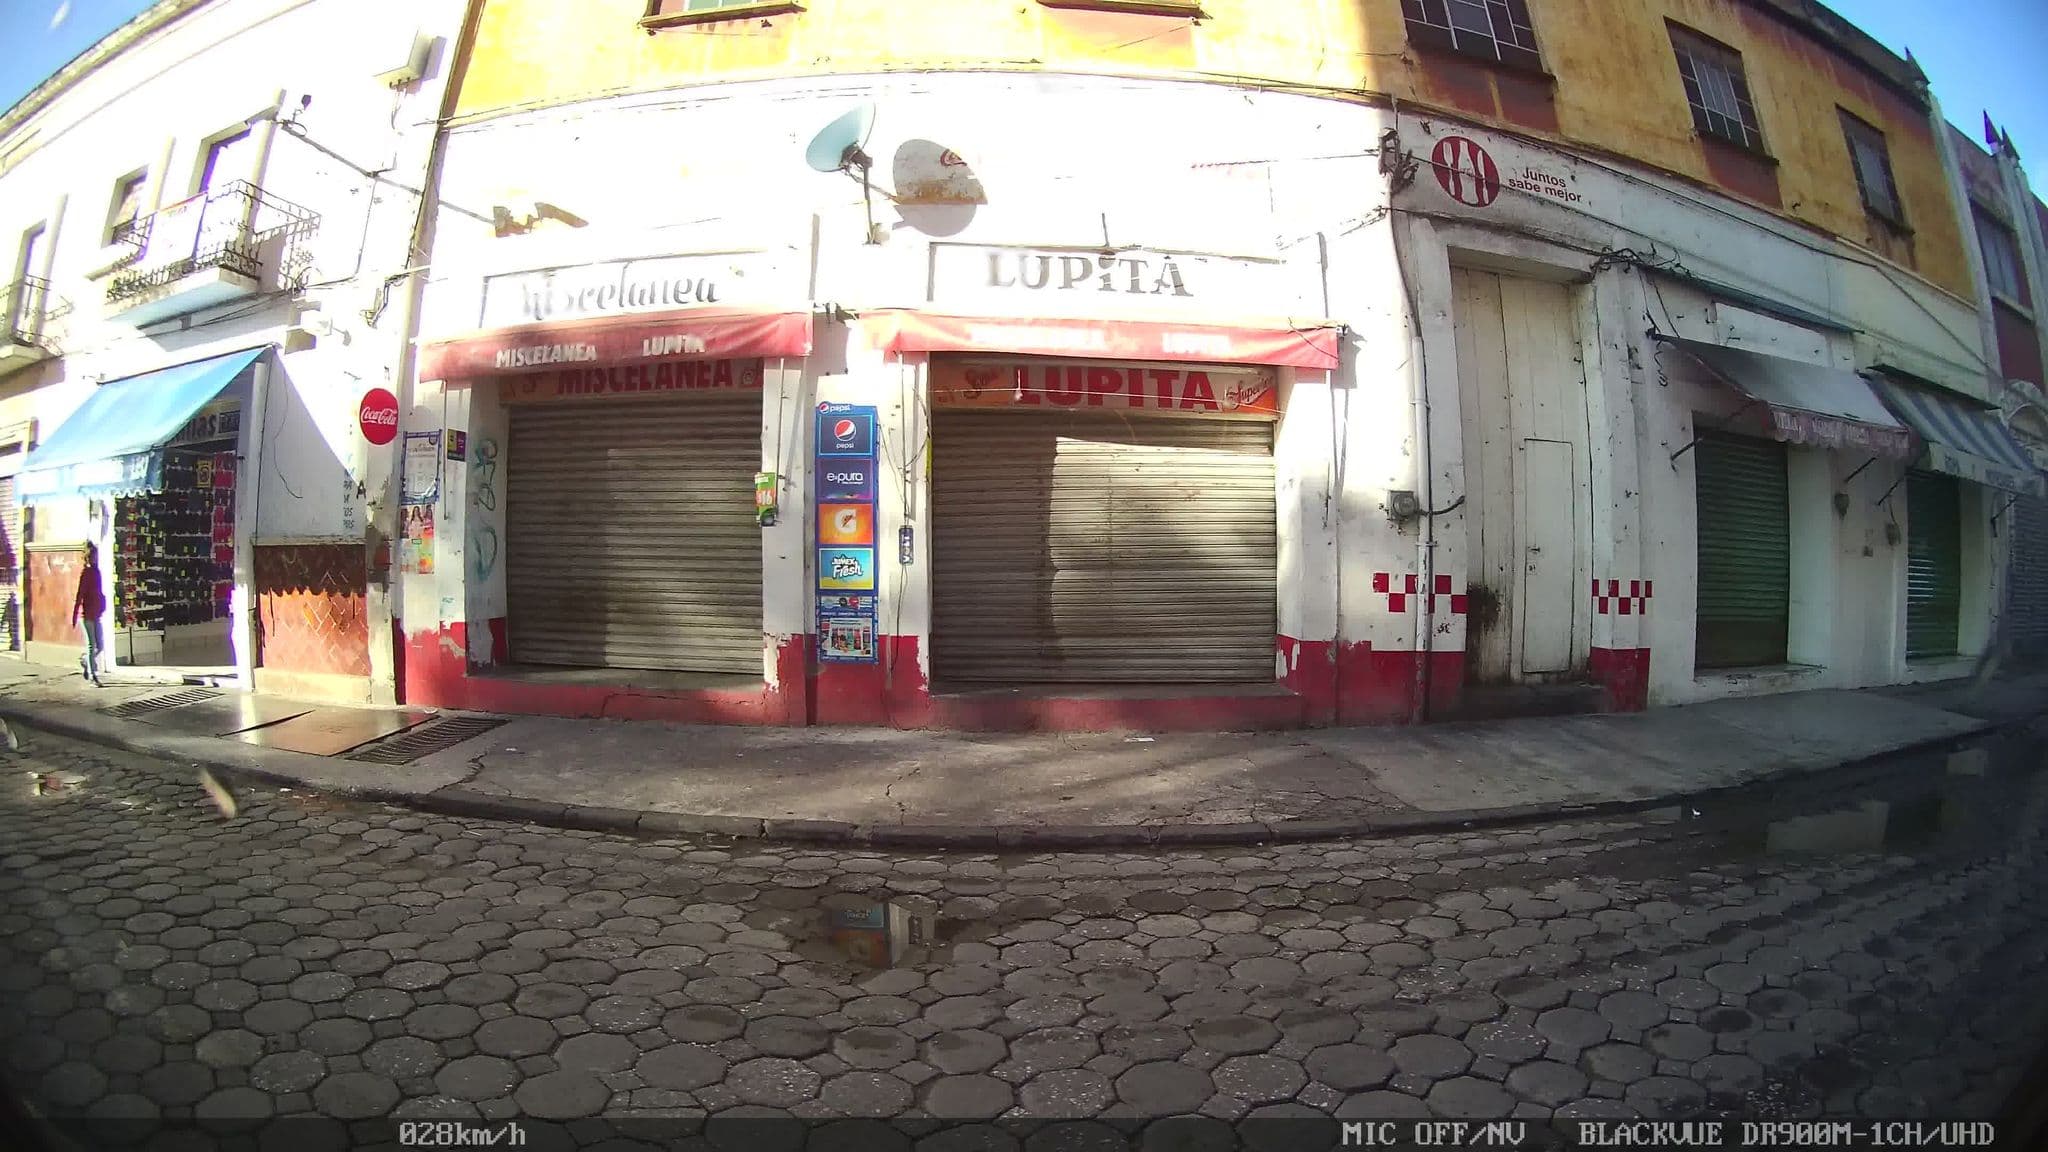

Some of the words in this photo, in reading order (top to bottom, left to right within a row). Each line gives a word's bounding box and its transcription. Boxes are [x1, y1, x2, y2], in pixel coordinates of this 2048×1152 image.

[1523, 168, 1566, 187] Juntos
[1508, 178, 1541, 192] sabe
[1544, 186, 1581, 203] mejor
[496, 343, 597, 368] MISCELANEA
[642, 334, 705, 356] LUPITA
[557, 360, 733, 394] MISCELANEA
[1012, 366, 1221, 411] LUPITA
[830, 404, 850, 412] pepsi
[833, 561, 863, 579] Fresh
